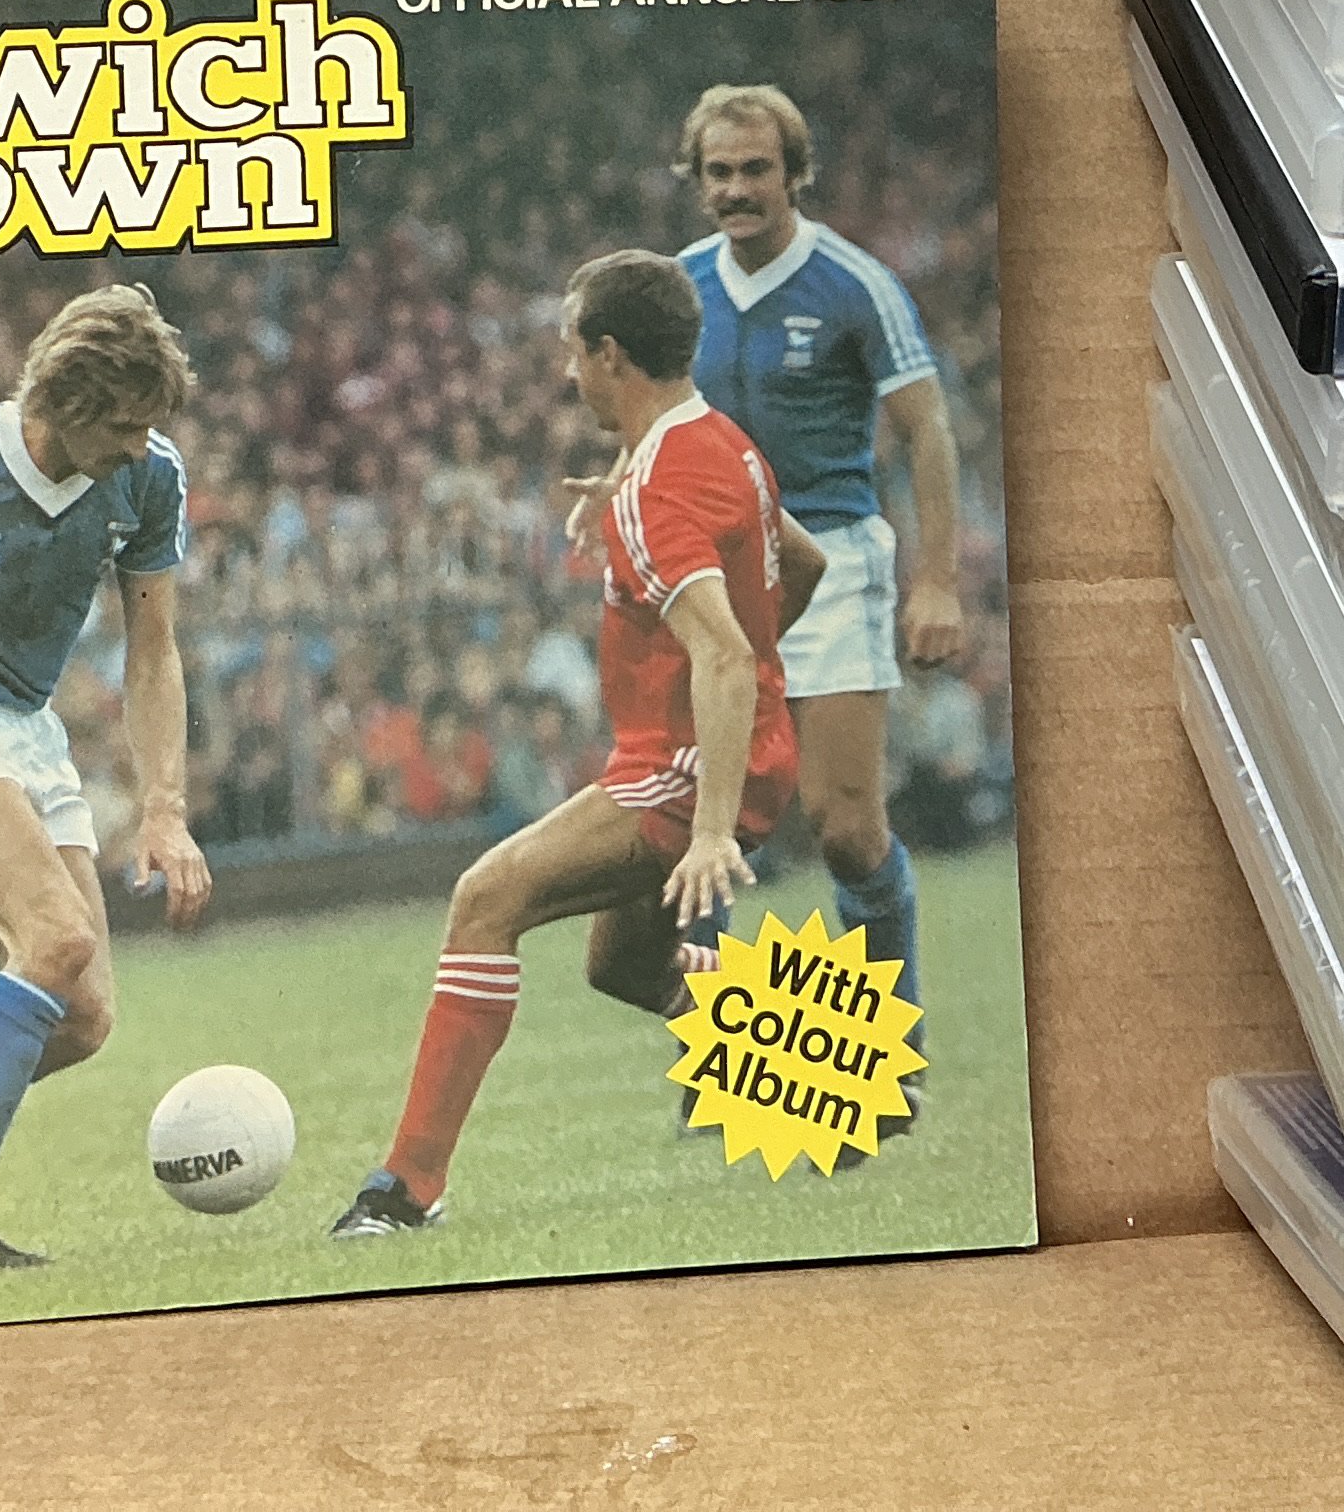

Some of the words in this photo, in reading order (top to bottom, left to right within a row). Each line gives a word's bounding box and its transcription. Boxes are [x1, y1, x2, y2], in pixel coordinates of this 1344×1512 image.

[768, 941, 882, 1023] With
[710, 986, 889, 1082] Colour
[690, 1042, 861, 1136] Album
